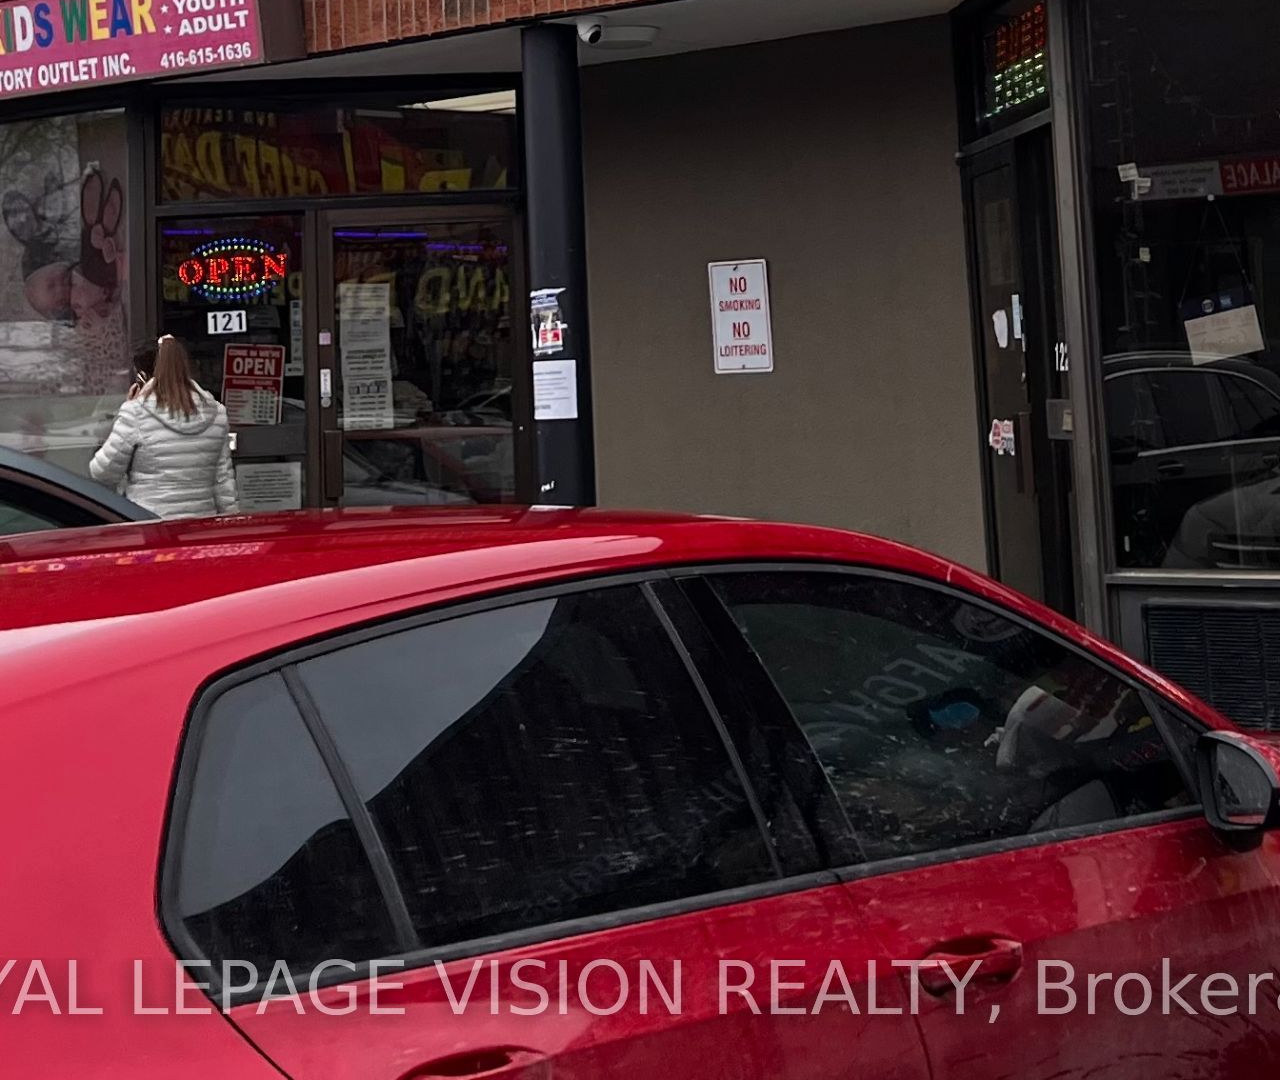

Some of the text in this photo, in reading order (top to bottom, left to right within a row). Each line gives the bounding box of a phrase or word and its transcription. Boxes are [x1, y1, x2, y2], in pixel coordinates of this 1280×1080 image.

[178, 9, 250, 36] ADULT
[160, 41, 252, 69] 416-615-1636
[38, 57, 100, 86] OUTLET
[102, 52, 137, 78] INC.
[178, 252, 288, 286] OPEN
[728, 276, 747, 293] NO
[719, 299, 761, 312] SMOKING
[211, 312, 244, 332] 121
[732, 321, 751, 338] NO
[719, 344, 767, 357] LOITERING
[233, 357, 276, 376] OPEN
